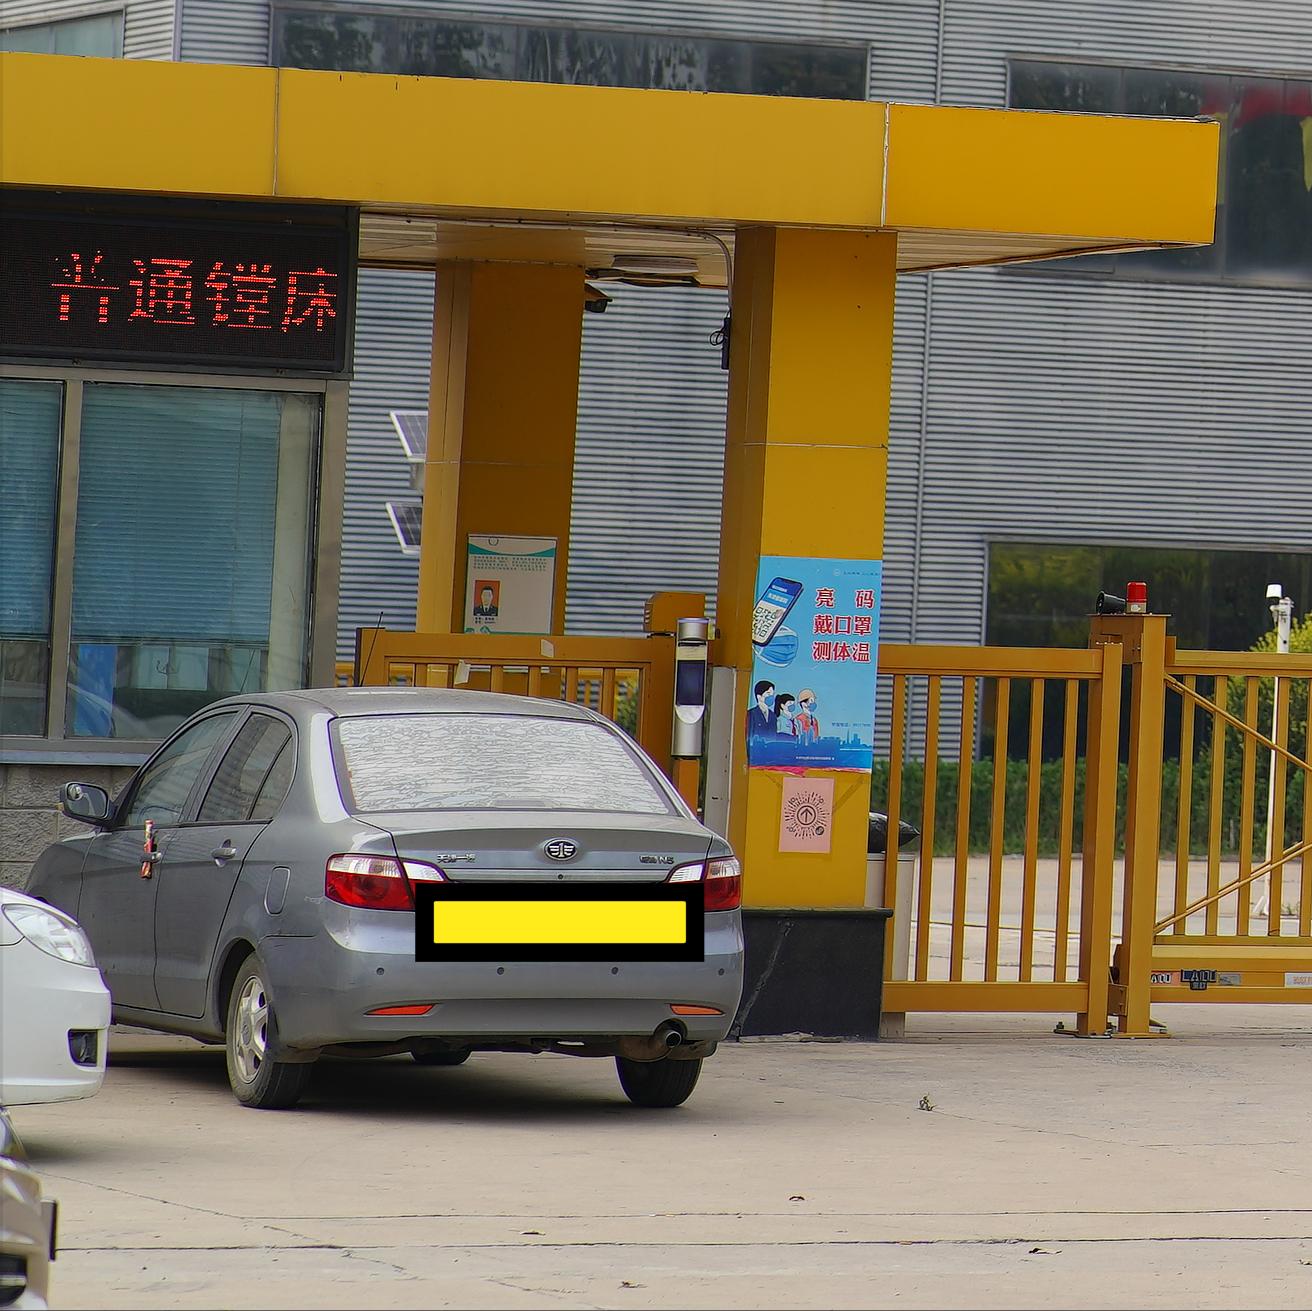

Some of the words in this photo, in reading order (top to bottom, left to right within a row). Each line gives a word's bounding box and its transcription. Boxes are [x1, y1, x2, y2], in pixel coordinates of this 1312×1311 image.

[50, 250, 338, 333] 普通镗床
[815, 588, 835, 608] 亮
[855, 590, 875, 609] 码
[812, 614, 872, 636] 戴口罩
[812, 641, 871, 663] 测体温
